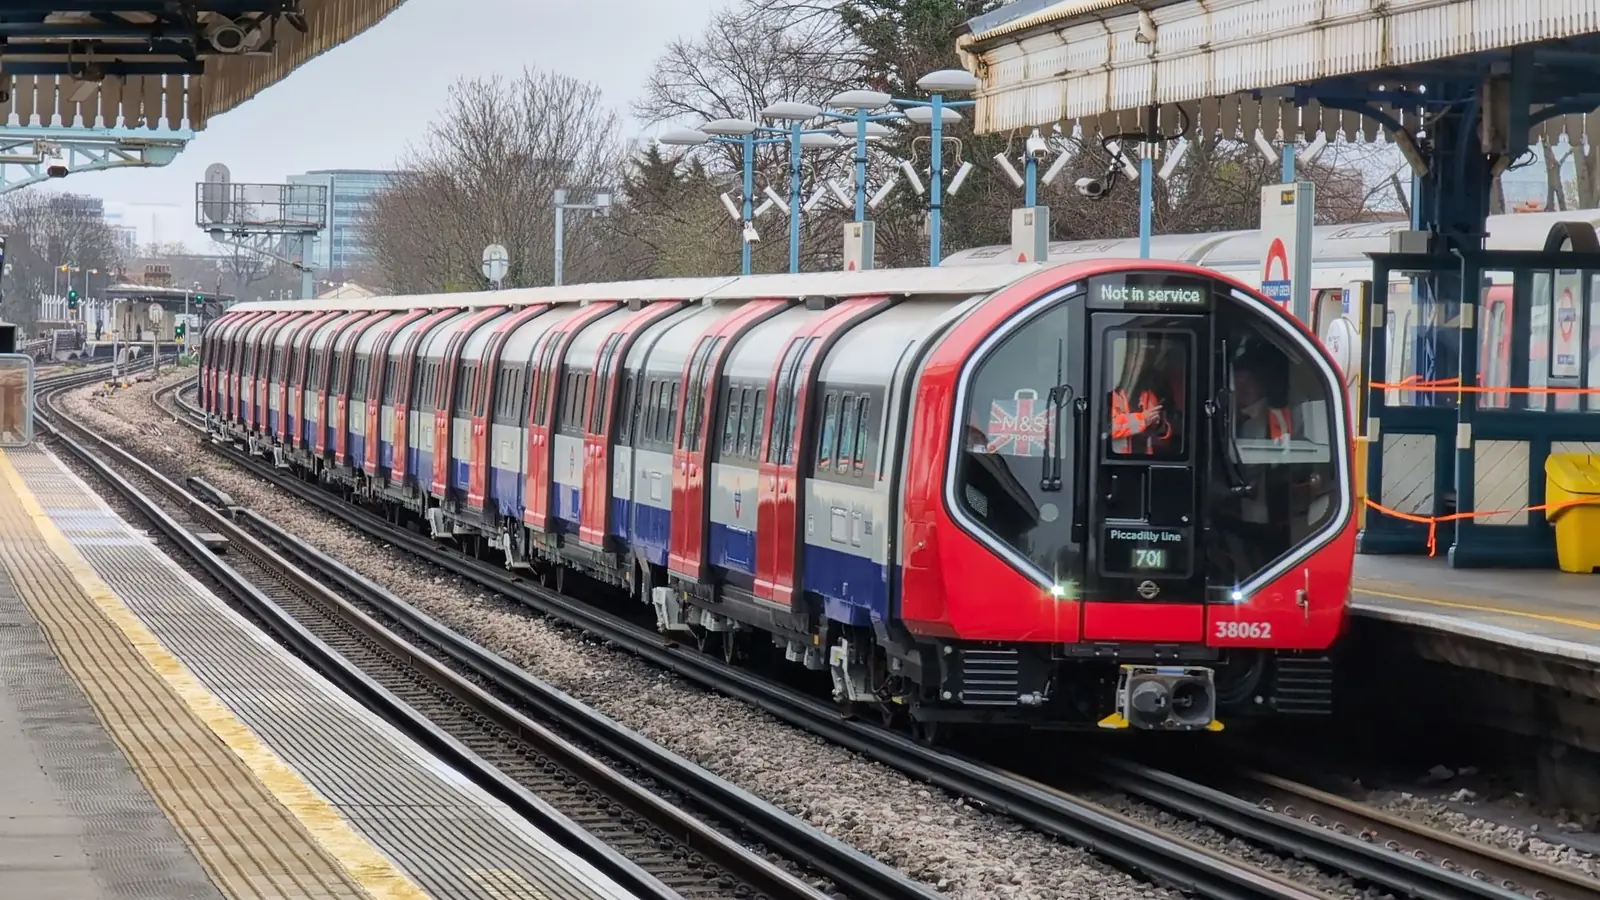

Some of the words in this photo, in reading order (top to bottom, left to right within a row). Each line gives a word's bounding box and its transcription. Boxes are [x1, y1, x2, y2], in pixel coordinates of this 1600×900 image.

[1100, 284, 1129, 301] Not
[1131, 286, 1144, 301] in
[1147, 287, 1200, 302] service
[1000, 415, 1045, 433] M&S
[1110, 529, 1160, 542] Piccadilly
[1136, 549, 1162, 567] 701
[1215, 621, 1272, 639] 38062
